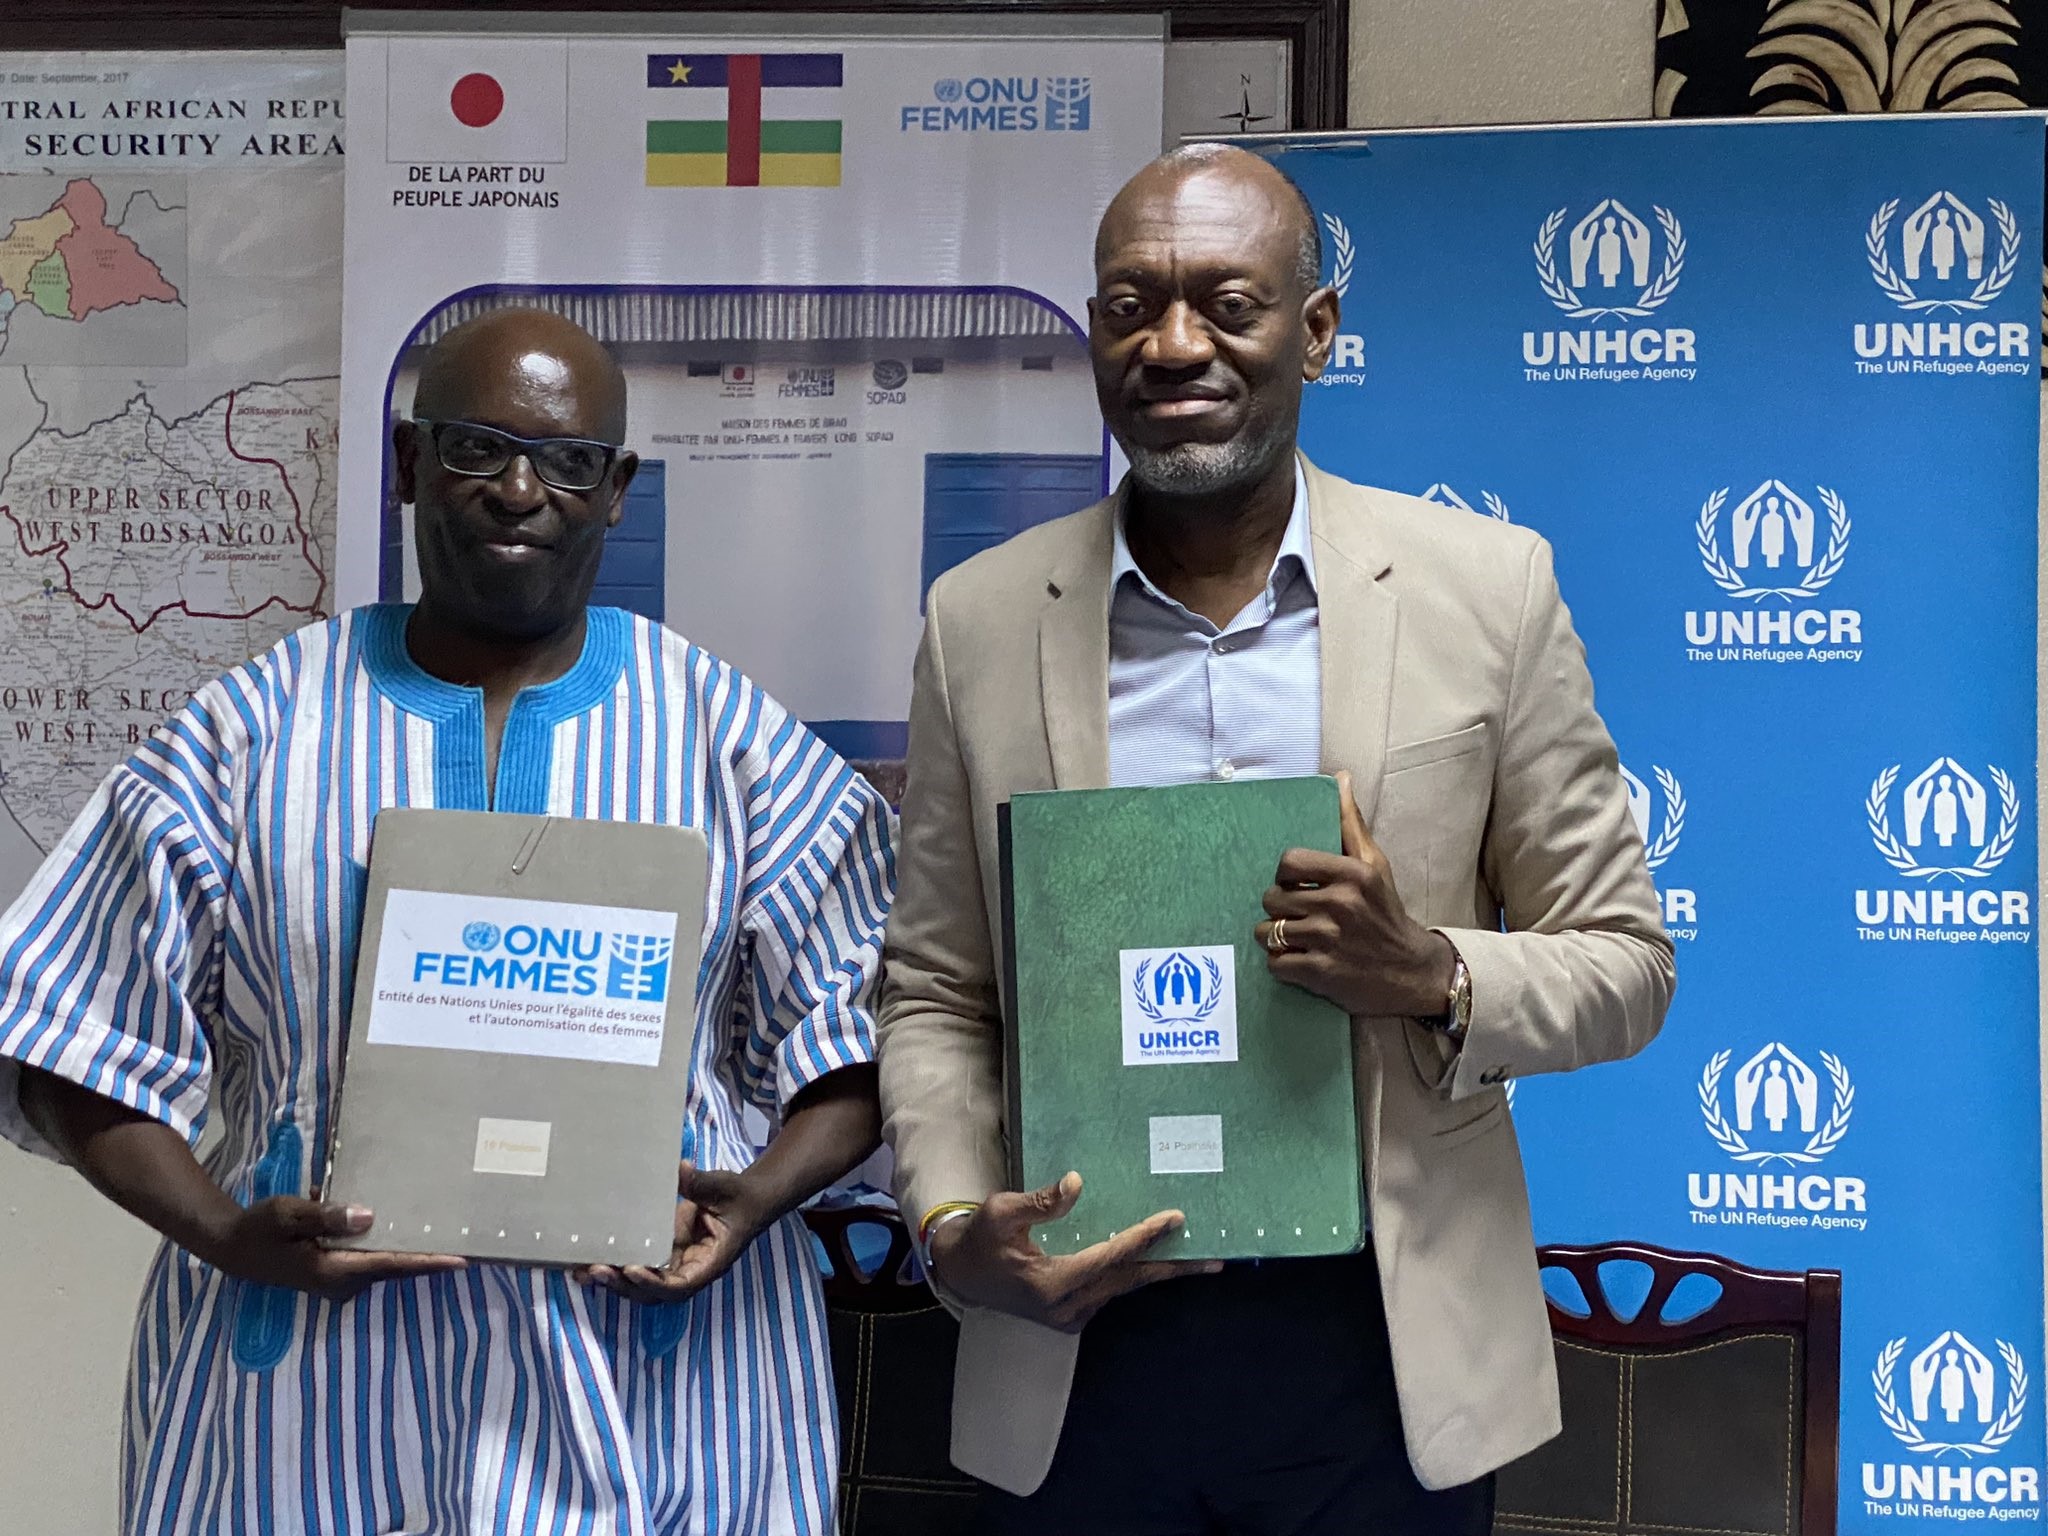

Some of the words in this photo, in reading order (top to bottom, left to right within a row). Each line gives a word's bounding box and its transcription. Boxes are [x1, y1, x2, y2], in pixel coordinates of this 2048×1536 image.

[11, 73, 37, 83] Date:
[103, 72, 128, 83] 2017
[1241, 74, 1251, 86] N
[966, 77, 1038, 102] ONU
[1, 100, 86, 119] TRAL
[102, 99, 246, 119] AFRICAN
[267, 99, 345, 118] REPU
[901, 106, 1038, 132] FEMMES
[25, 133, 222, 156] SECURITY
[240, 133, 345, 156] AREA
[409, 166, 432, 182] DE
[439, 166, 462, 182] LA
[467, 166, 513, 183] PART
[519, 167, 545, 183] DU
[393, 190, 463, 207] PEUPLE
[468, 191, 559, 208] JAPONAIS
[1522, 328, 1697, 366] UNHCR
[1854, 322, 2030, 358] UNHCR
[1524, 368, 1552, 382] The
[1554, 368, 1576, 381] UN
[1579, 366, 1639, 382] Refugee
[1642, 365, 1697, 382] Agency
[1855, 361, 1885, 374] The
[1887, 360, 1910, 374] UN
[1913, 360, 1973, 375] Refugee
[1976, 360, 2030, 375] Agency
[48, 486, 140, 509] UPPER
[158, 487, 273, 511] SECTOR
[25, 521, 101, 543] WEST
[120, 522, 296, 545] BOSSANGOA
[1685, 609, 1862, 645] UNHCR
[1686, 648, 1714, 661] The
[1716, 648, 1739, 661] UN
[1743, 648, 1803, 663] Refugee
[1806, 647, 1862, 662] Agency
[15, 721, 97, 744] WEST
[1855, 890, 2030, 926] UNHCR
[504, 925, 602, 961] ONU
[1856, 927, 1885, 941] The
[1888, 927, 1912, 941] UN
[1915, 927, 1977, 943] Refugee
[1979, 927, 2030, 944] Agency
[413, 952, 599, 996] FEMMES
[379, 990, 414, 1003] Entité
[416, 993, 437, 1005] des
[440, 996, 486, 1009] Nations
[489, 998, 523, 1011] Unies
[525, 1002, 554, 1015] pour
[606, 1008, 627, 1020] des
[629, 1012, 662, 1024] sexes
[469, 1014, 480, 1023] et
[588, 1022, 610, 1034] des
[612, 1023, 660, 1039] femmes
[1139, 1030, 1220, 1049] UNHCR
[1166, 1049, 1194, 1057] Refugee
[1195, 1048, 1220, 1056] Agency
[1687, 1173, 1867, 1212] UNHCR
[1689, 1211, 1718, 1225] The
[1720, 1211, 1743, 1225] UN
[1747, 1212, 1808, 1229] Refugee
[1811, 1213, 1868, 1231] Agency
[1862, 1463, 2039, 1503] UNHCR
[1864, 1501, 1892, 1515] The
[1896, 1502, 1919, 1517] UN
[1923, 1503, 1985, 1520] Refugee
[1988, 1505, 2040, 1522] Agency
